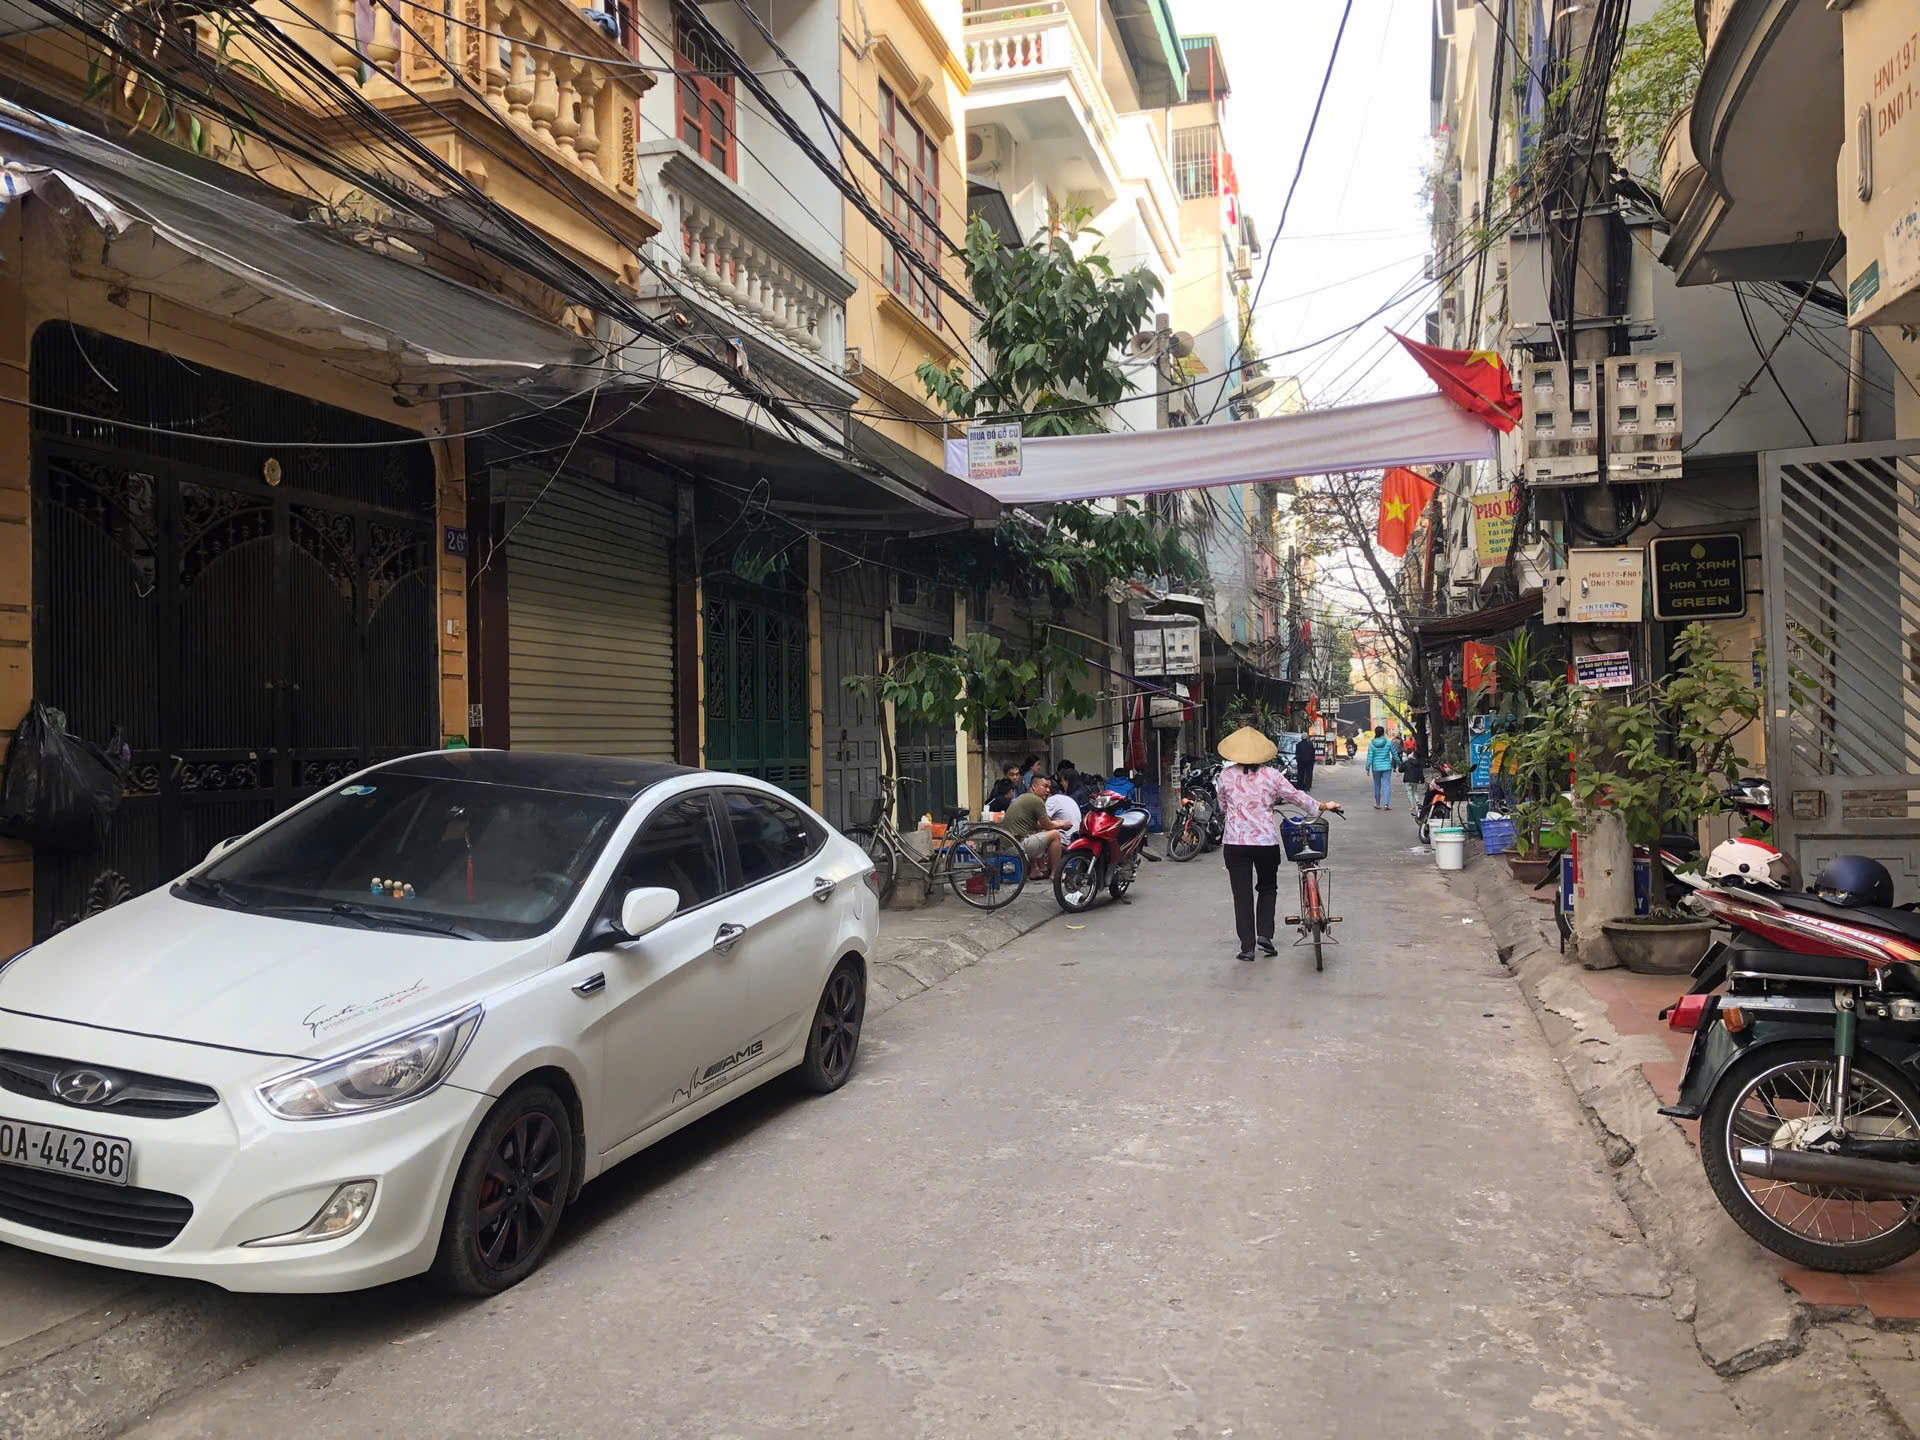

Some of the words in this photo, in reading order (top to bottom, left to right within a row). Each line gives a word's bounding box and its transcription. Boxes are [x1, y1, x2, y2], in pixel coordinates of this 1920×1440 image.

[970, 431, 985, 441] MUA
[1662, 561, 1690, 572] CÂY
[1696, 560, 1736, 570] XANH
[1669, 581, 1696, 590] HOA
[1671, 594, 1730, 608] GREEN
[721, 1040, 763, 1070] AMG
